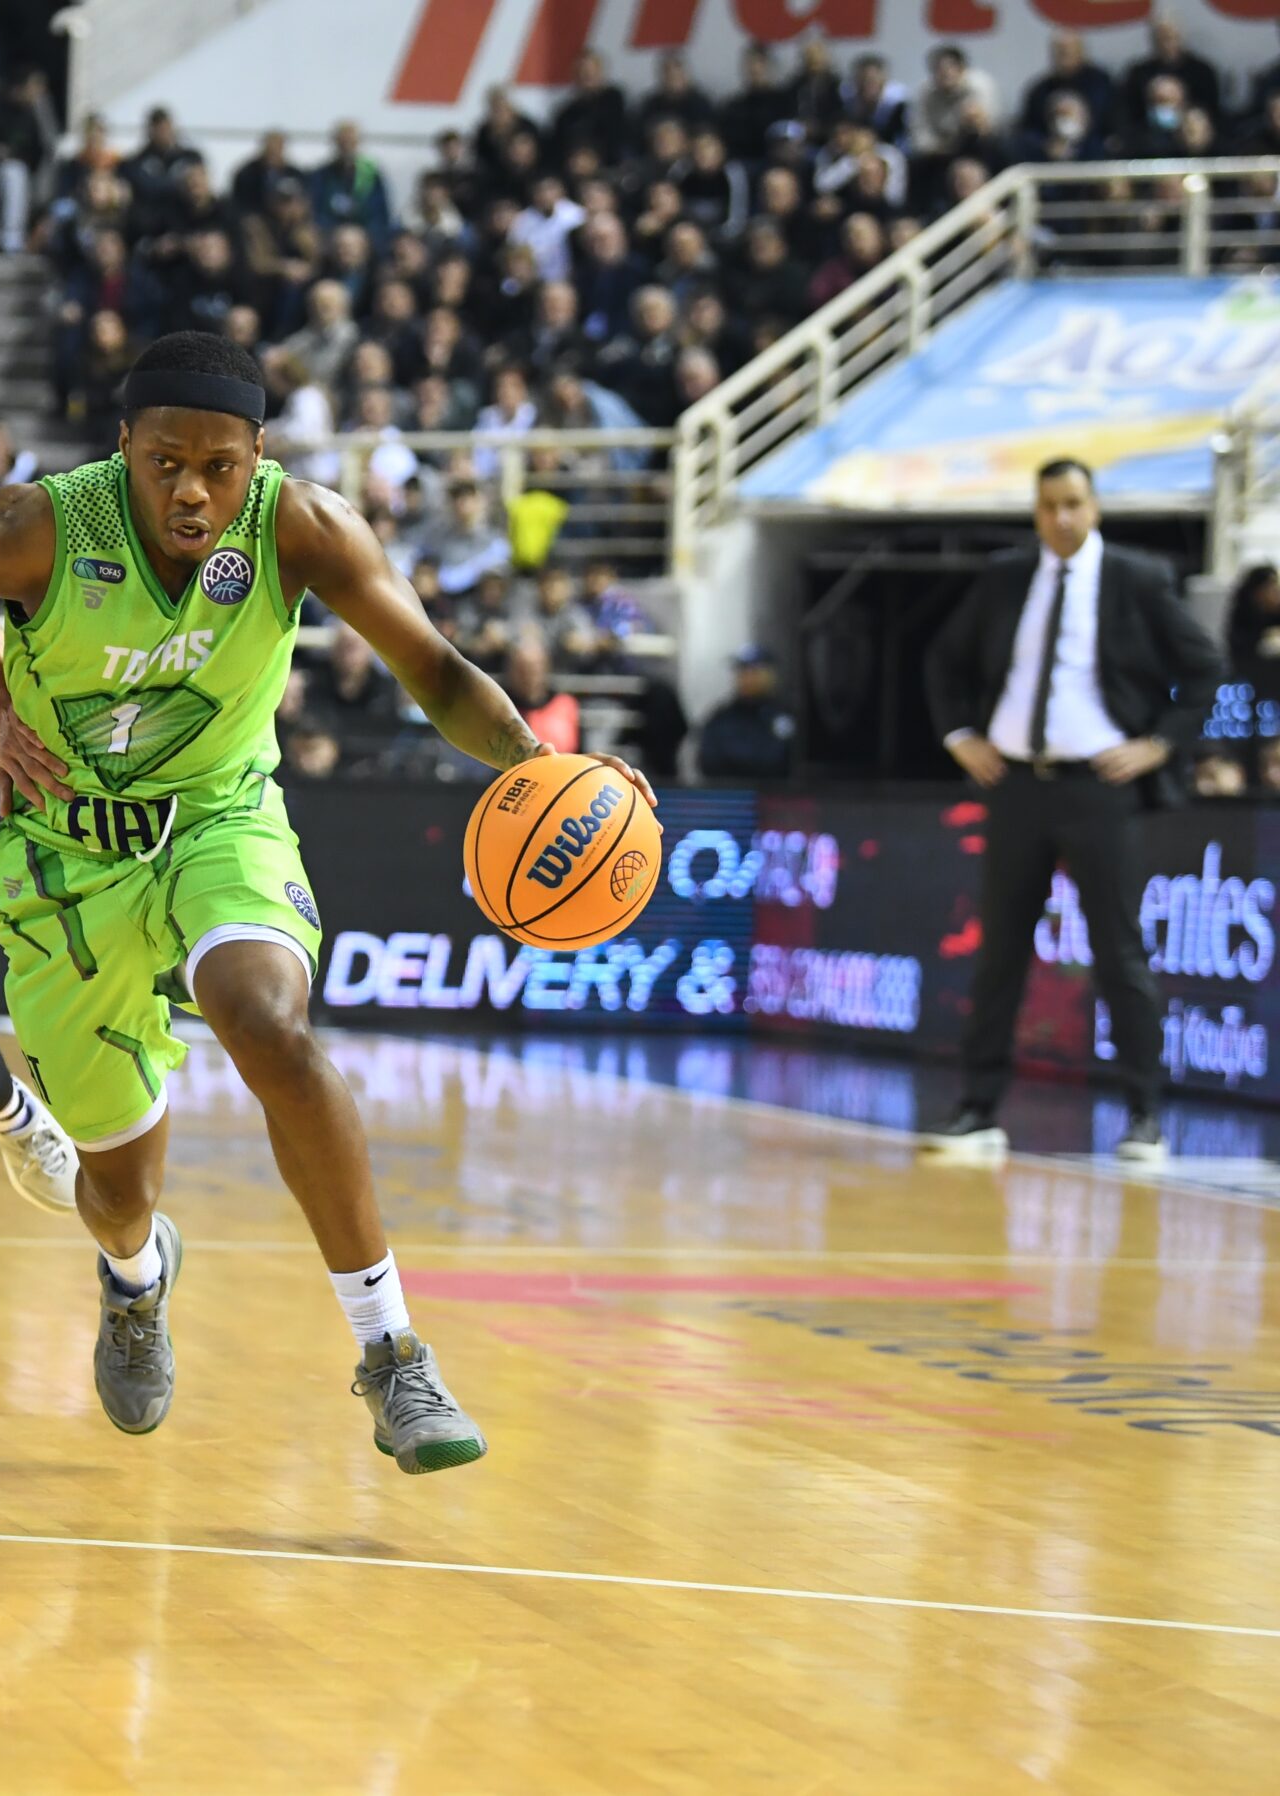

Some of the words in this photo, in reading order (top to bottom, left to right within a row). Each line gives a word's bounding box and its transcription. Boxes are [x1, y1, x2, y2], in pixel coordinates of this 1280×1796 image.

[99, 566, 122, 579] TOFAS
[107, 703, 143, 756] 1
[497, 777, 531, 812] FIBA
[511, 781, 539, 815] APPROVED
[526, 784, 624, 889] Wilson
[323, 931, 683, 1012] DELIVERY
